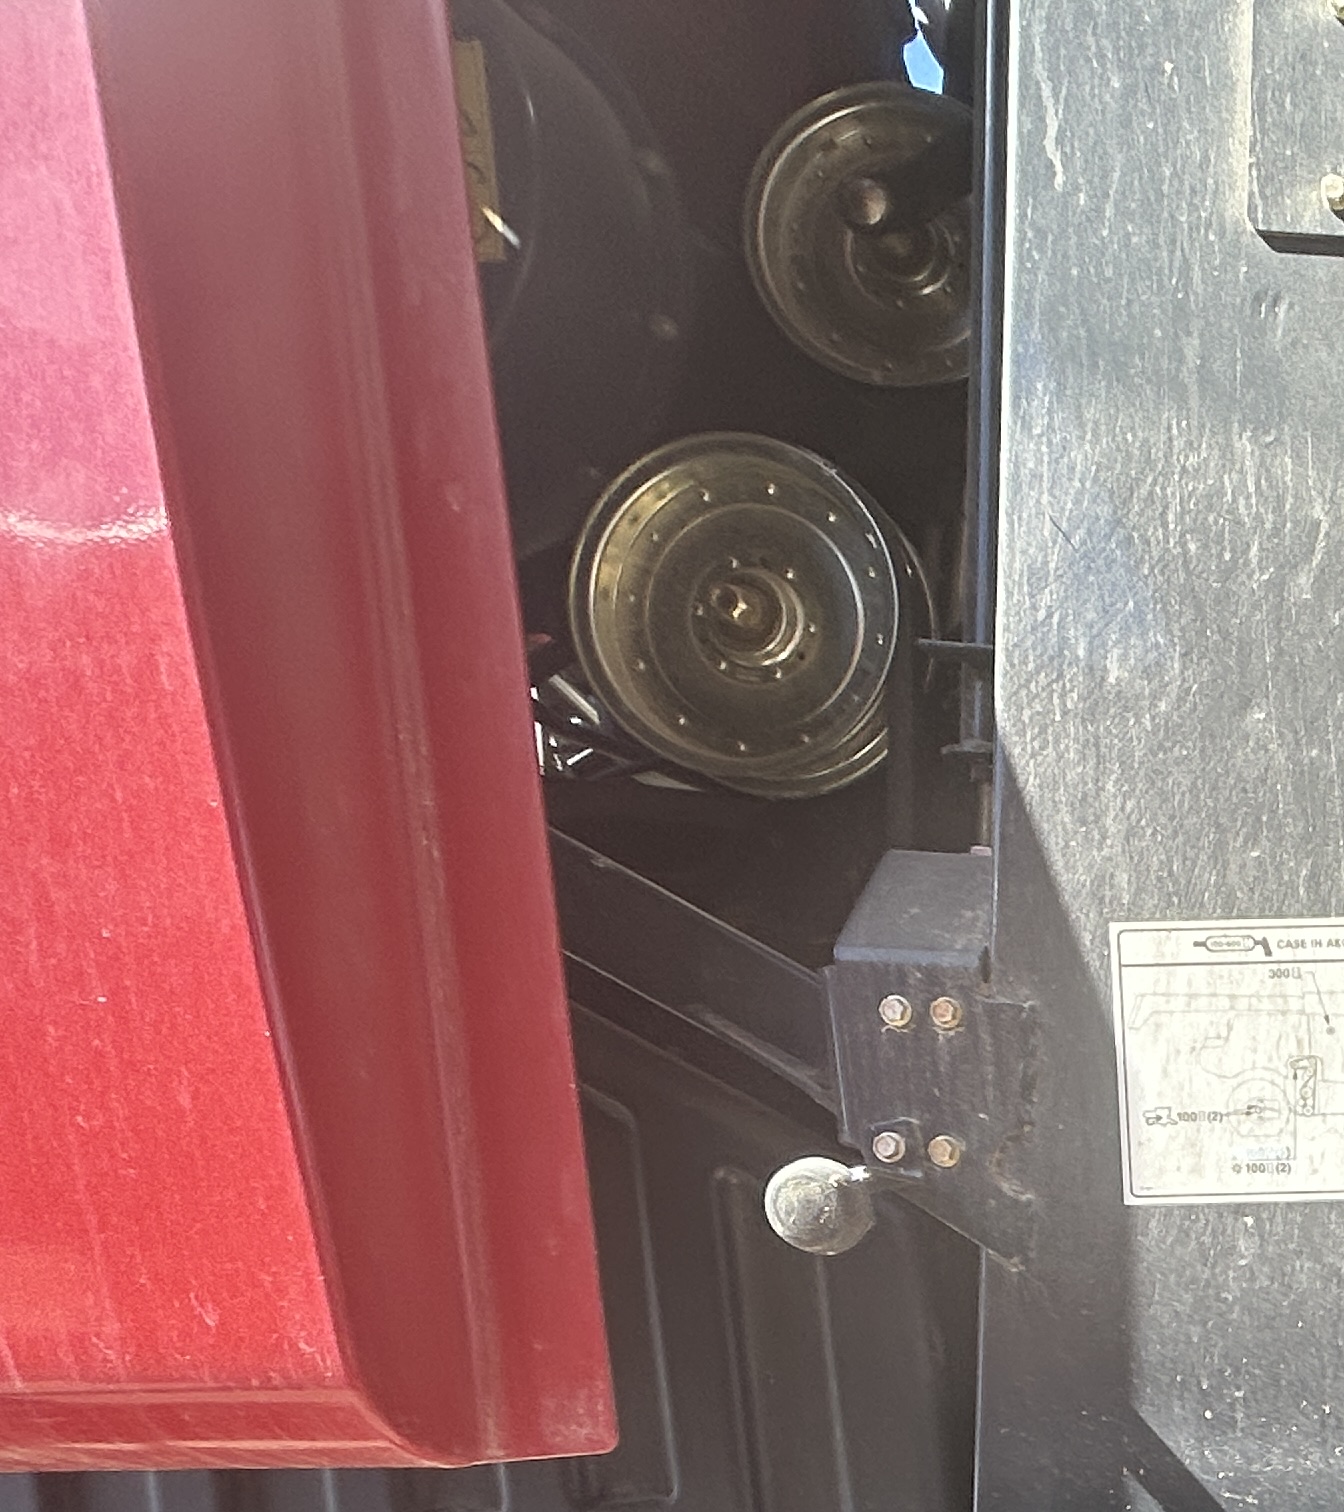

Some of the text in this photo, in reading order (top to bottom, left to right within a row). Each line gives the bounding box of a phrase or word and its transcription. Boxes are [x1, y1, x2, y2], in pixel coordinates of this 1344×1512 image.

[1276, 939, 1307, 950] CASE
[1268, 967, 1290, 979] 300
[1177, 1111, 1223, 1124] 100 (2)
[1245, 1162, 1291, 1175] 100 (2)
